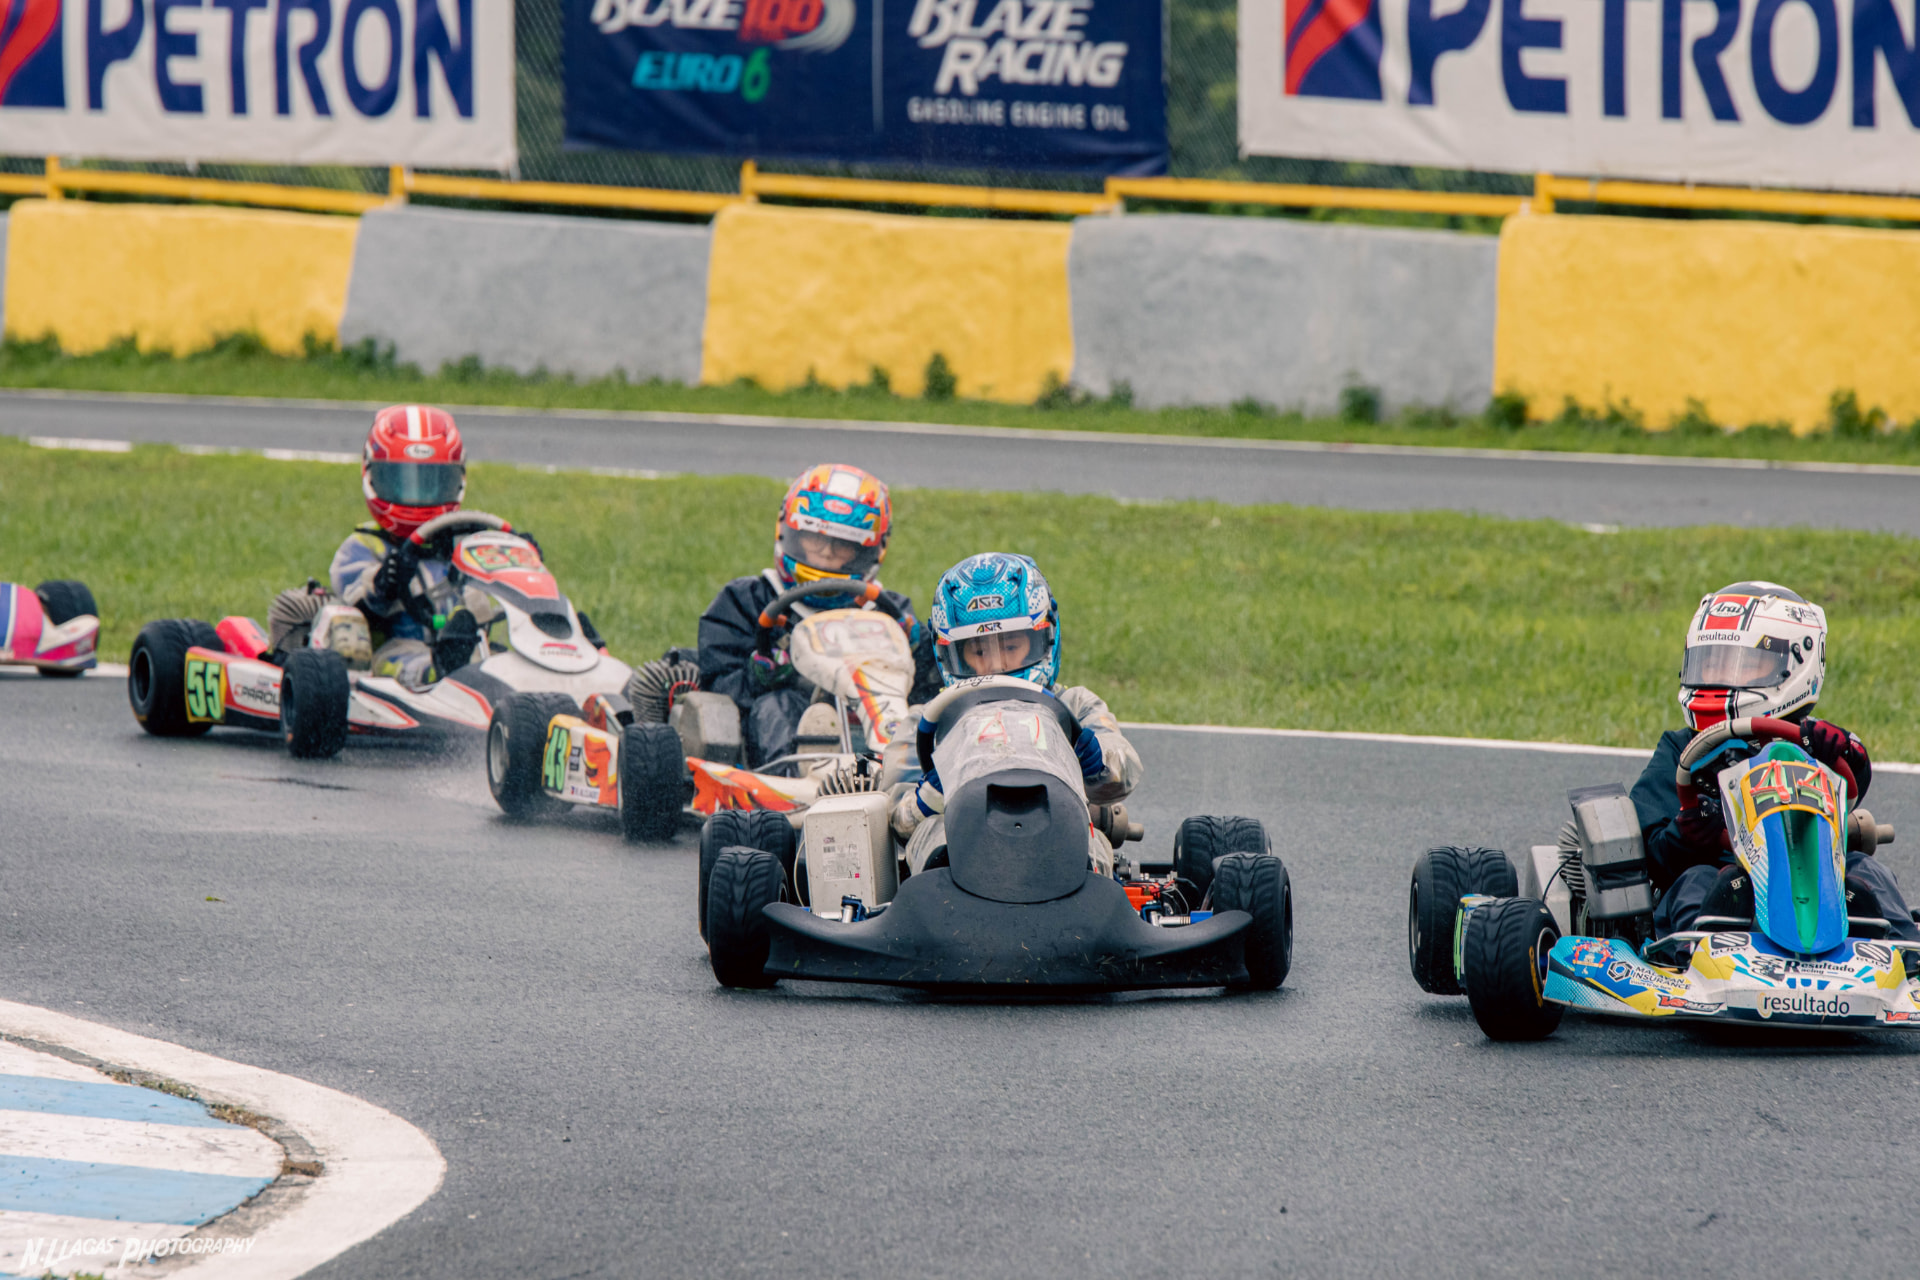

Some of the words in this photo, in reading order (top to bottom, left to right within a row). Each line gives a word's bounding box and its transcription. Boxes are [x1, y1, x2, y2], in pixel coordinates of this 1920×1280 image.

[907, 0, 1094, 48] BLAZE
[86, 0, 475, 119] PETRON
[934, 38, 1120, 95] RACING
[906, 97, 1007, 126] GASOLINE
[1009, 101, 1088, 129] ENGINE
[1091, 104, 1130, 131] OIL
[1697, 631, 1741, 642] resultado
[187, 660, 222, 720] 55
[544, 727, 568, 791] 43
[1632, 972, 1692, 990] INSURANCE
[1635, 966, 1685, 984] MALAYAN
[1763, 992, 1850, 1015] resultado
